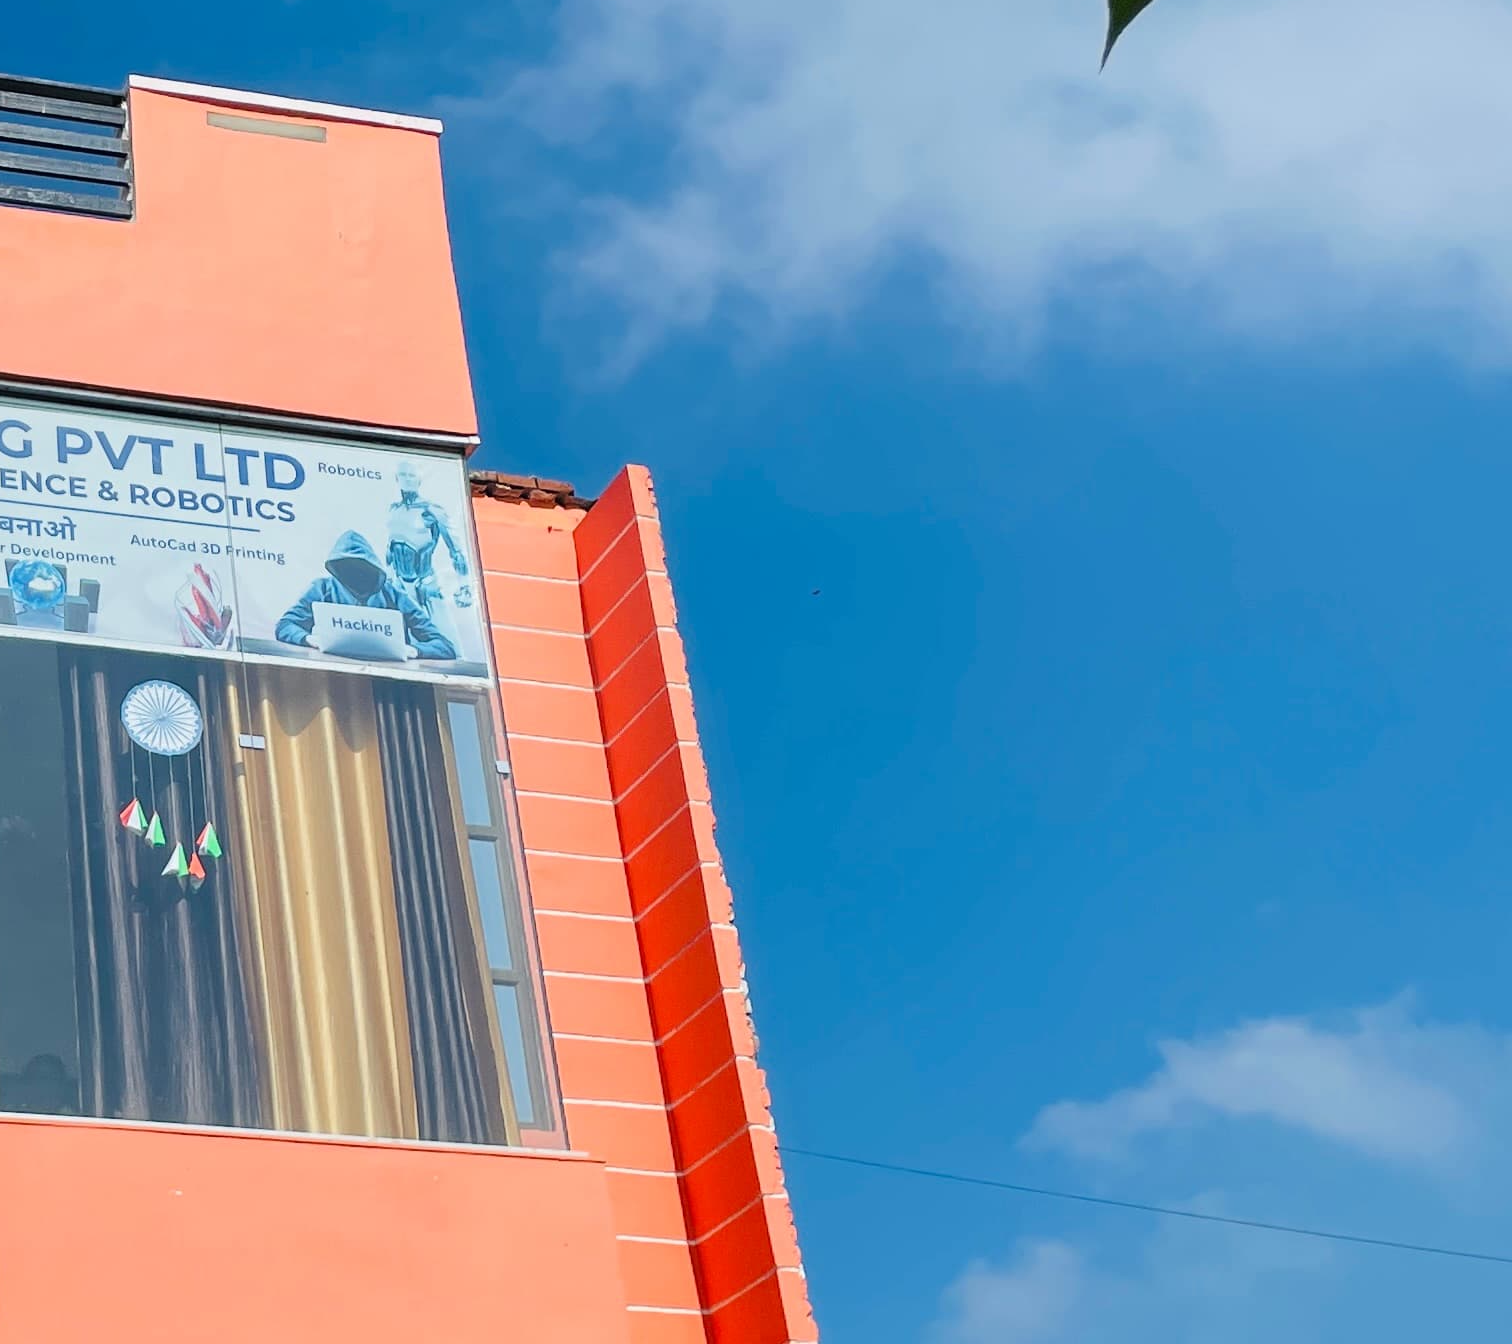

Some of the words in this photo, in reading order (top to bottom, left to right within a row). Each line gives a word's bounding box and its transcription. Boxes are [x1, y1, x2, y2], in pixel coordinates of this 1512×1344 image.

[56, 425, 174, 475] PVT
[194, 443, 306, 491] LTD
[318, 462, 382, 480] Robotics
[97, 480, 119, 502] &
[130, 483, 296, 523] ROBOTICS
[11, 543, 117, 566] Development
[130, 534, 197, 553] AutoCad
[201, 542, 221, 555] 3D
[226, 545, 286, 565] Printing
[331, 616, 393, 636] Hacking
